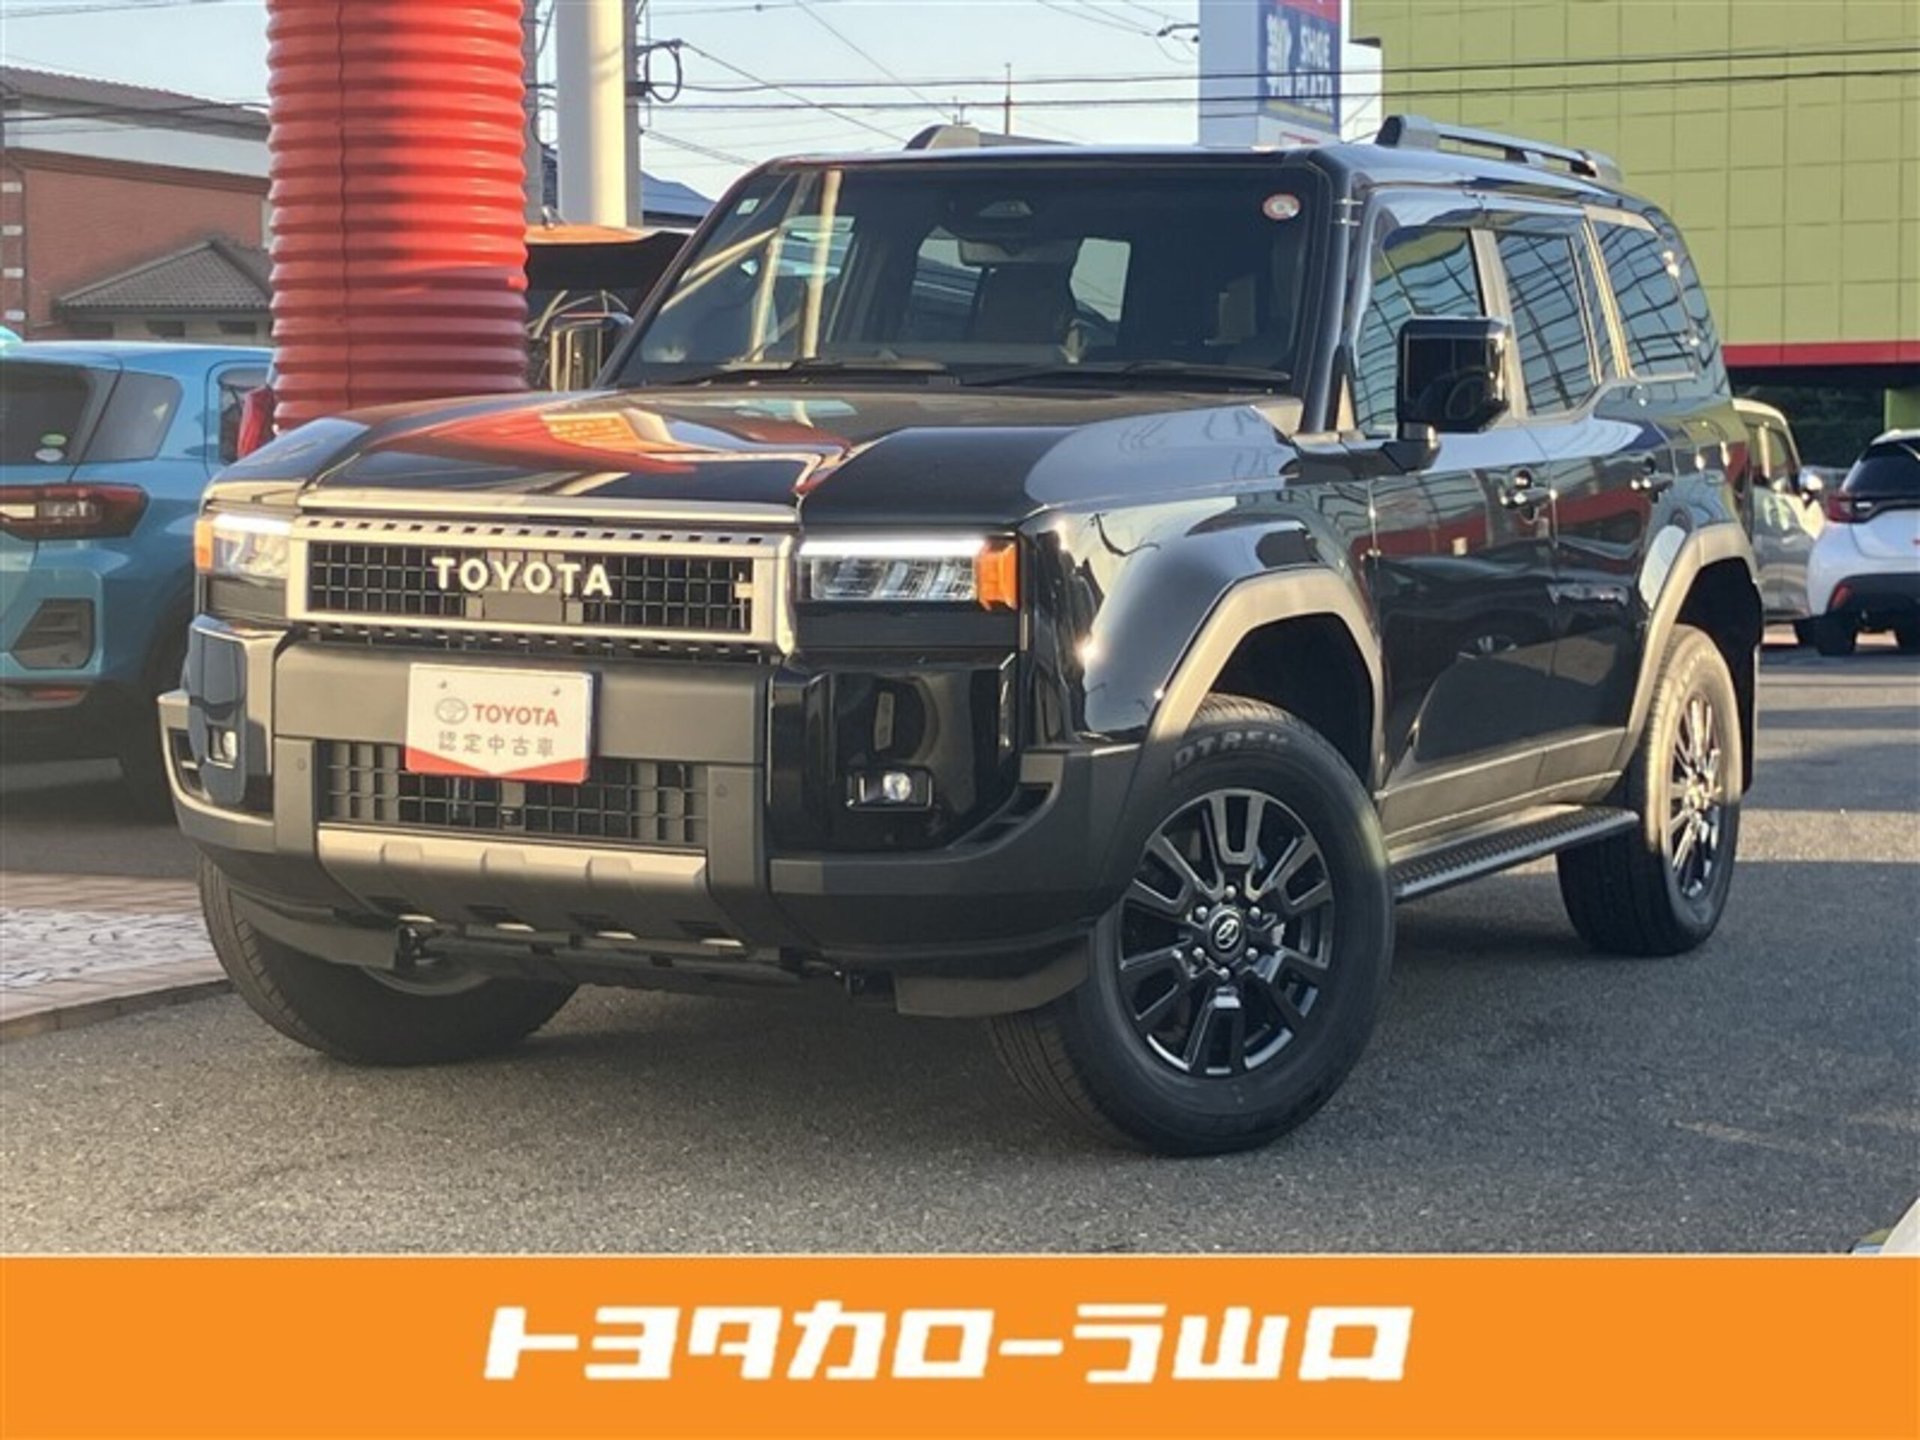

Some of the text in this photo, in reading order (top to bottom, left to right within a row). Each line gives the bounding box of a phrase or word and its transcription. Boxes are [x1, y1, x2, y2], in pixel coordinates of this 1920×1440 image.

[431, 556, 613, 597] TOYOTA
[473, 703, 559, 728] TOYOTA
[438, 731, 554, 758] 認定中古車
